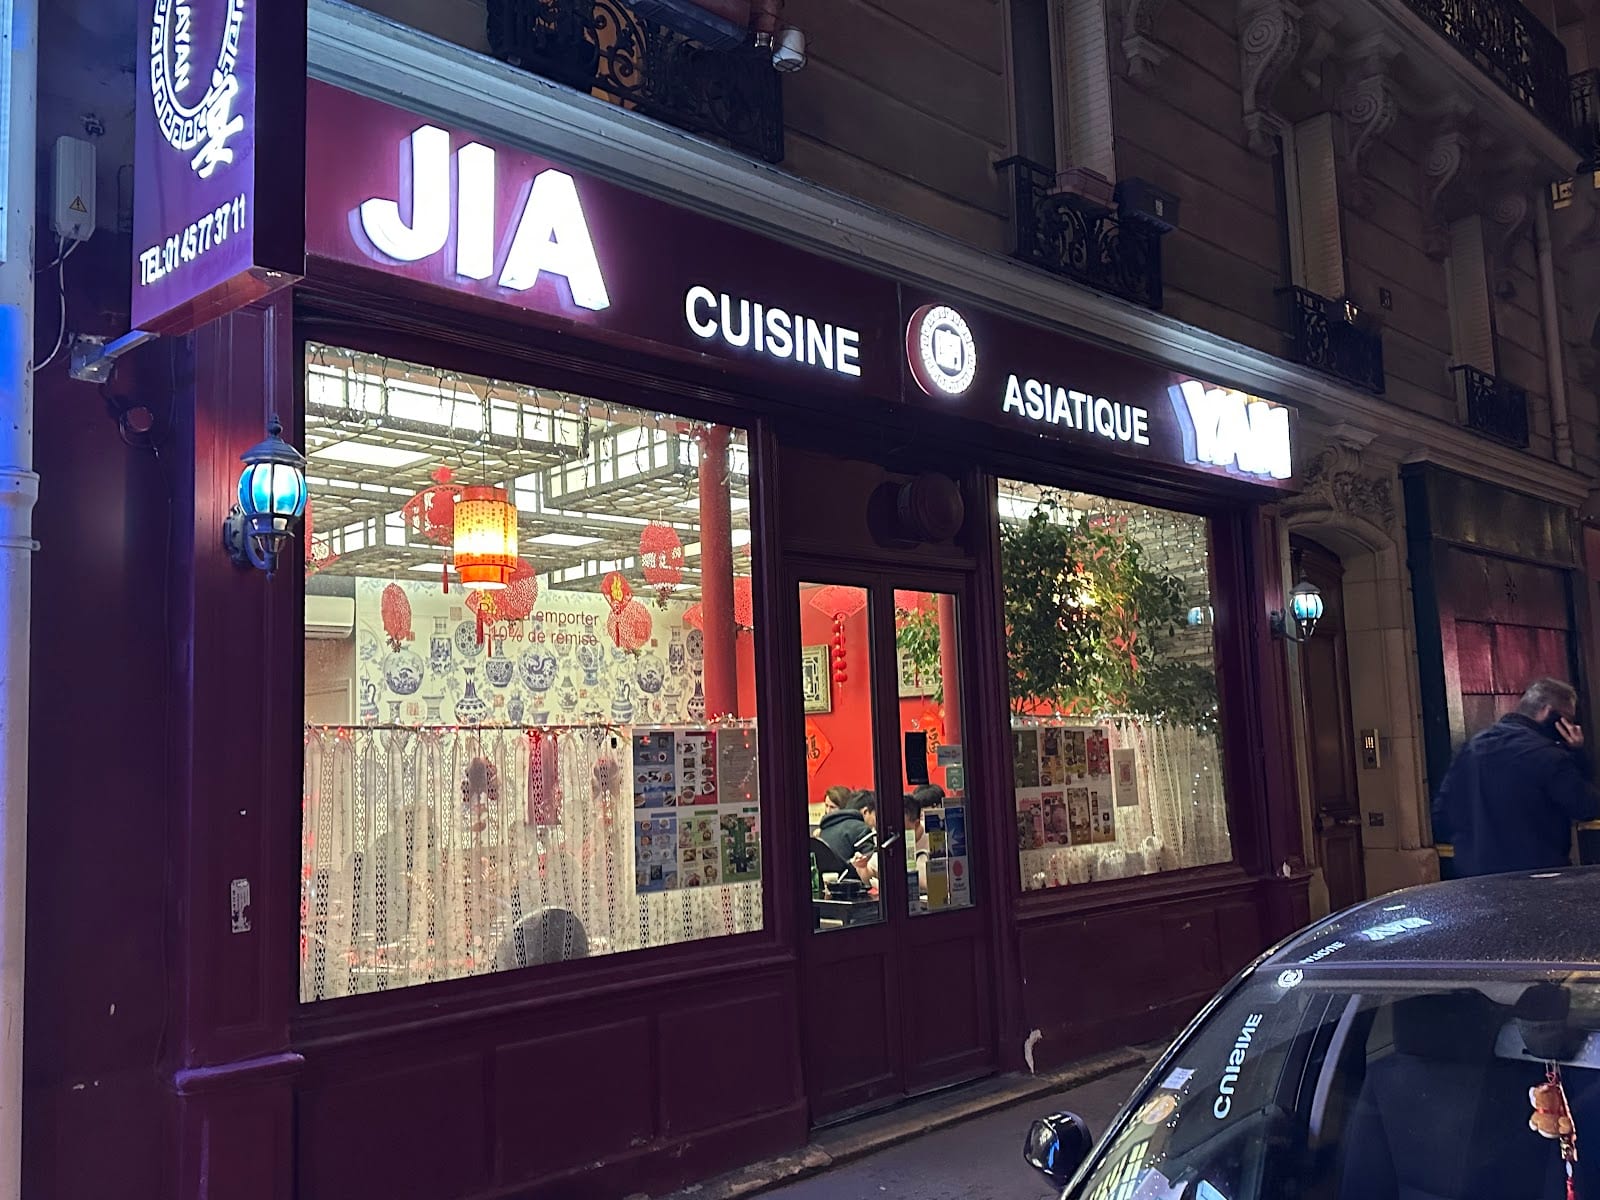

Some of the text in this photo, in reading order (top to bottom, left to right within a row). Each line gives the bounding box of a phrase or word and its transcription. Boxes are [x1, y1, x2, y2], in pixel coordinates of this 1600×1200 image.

[231, 192, 246, 234] 11
[356, 123, 611, 312] JIA
[685, 285, 862, 378] CUISINE
[1002, 373, 1151, 447] ASIATIQUE
[1174, 380, 1292, 480] YAN
[528, 627, 546, 644] de
[551, 631, 598, 647] remise
[535, 610, 600, 628] emporter
